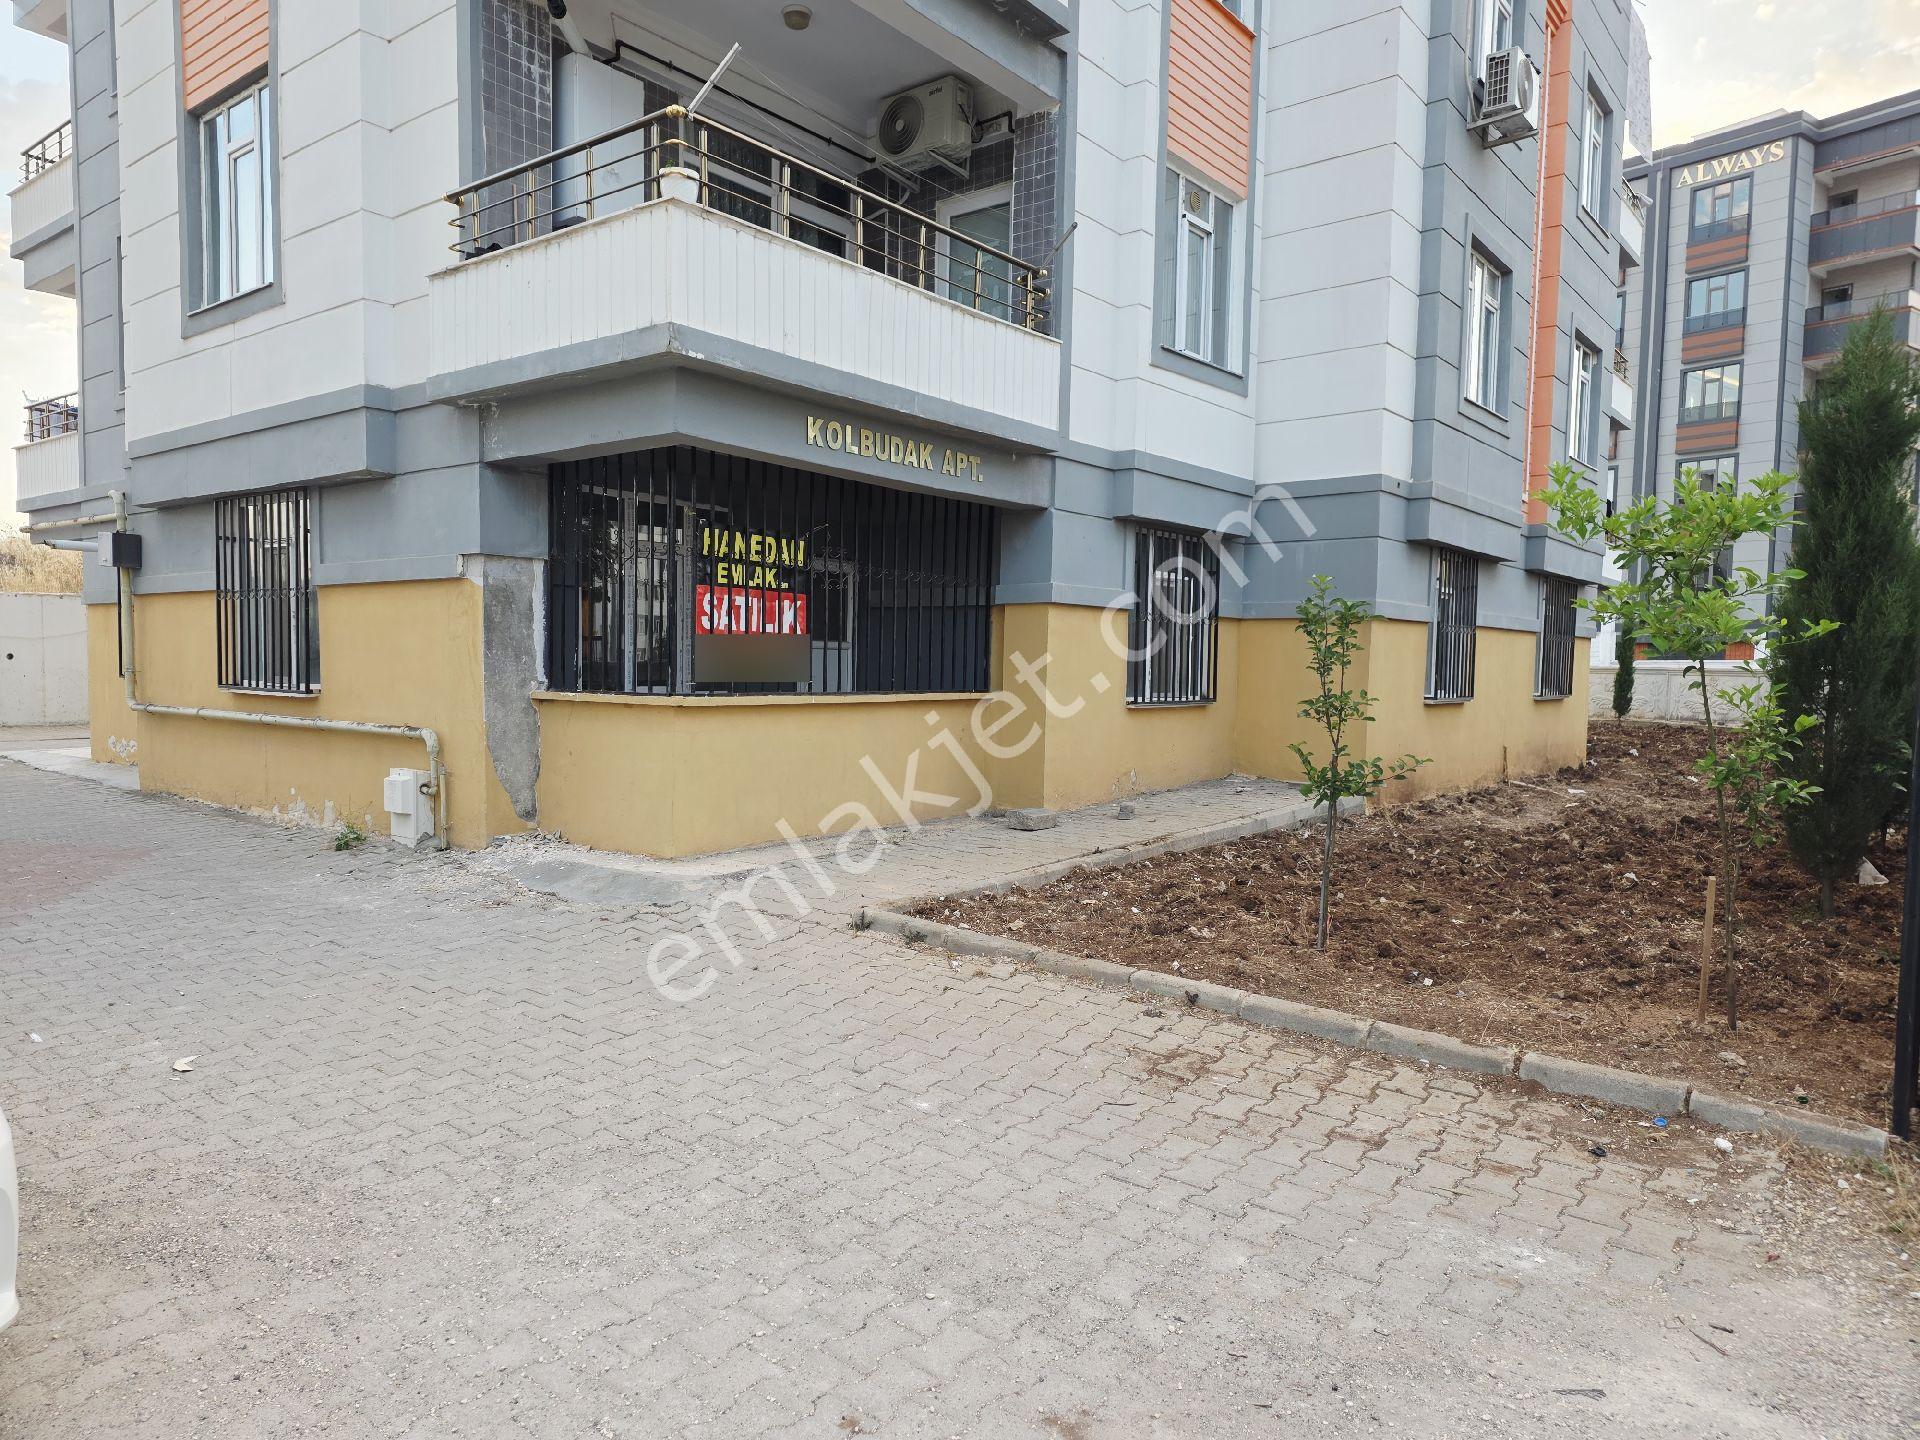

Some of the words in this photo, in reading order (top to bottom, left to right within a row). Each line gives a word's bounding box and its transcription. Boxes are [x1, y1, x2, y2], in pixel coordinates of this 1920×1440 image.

[1677, 141, 1785, 188] ALWAYS
[807, 415, 934, 471] KOLBUDAK
[941, 448, 984, 482] APT.
